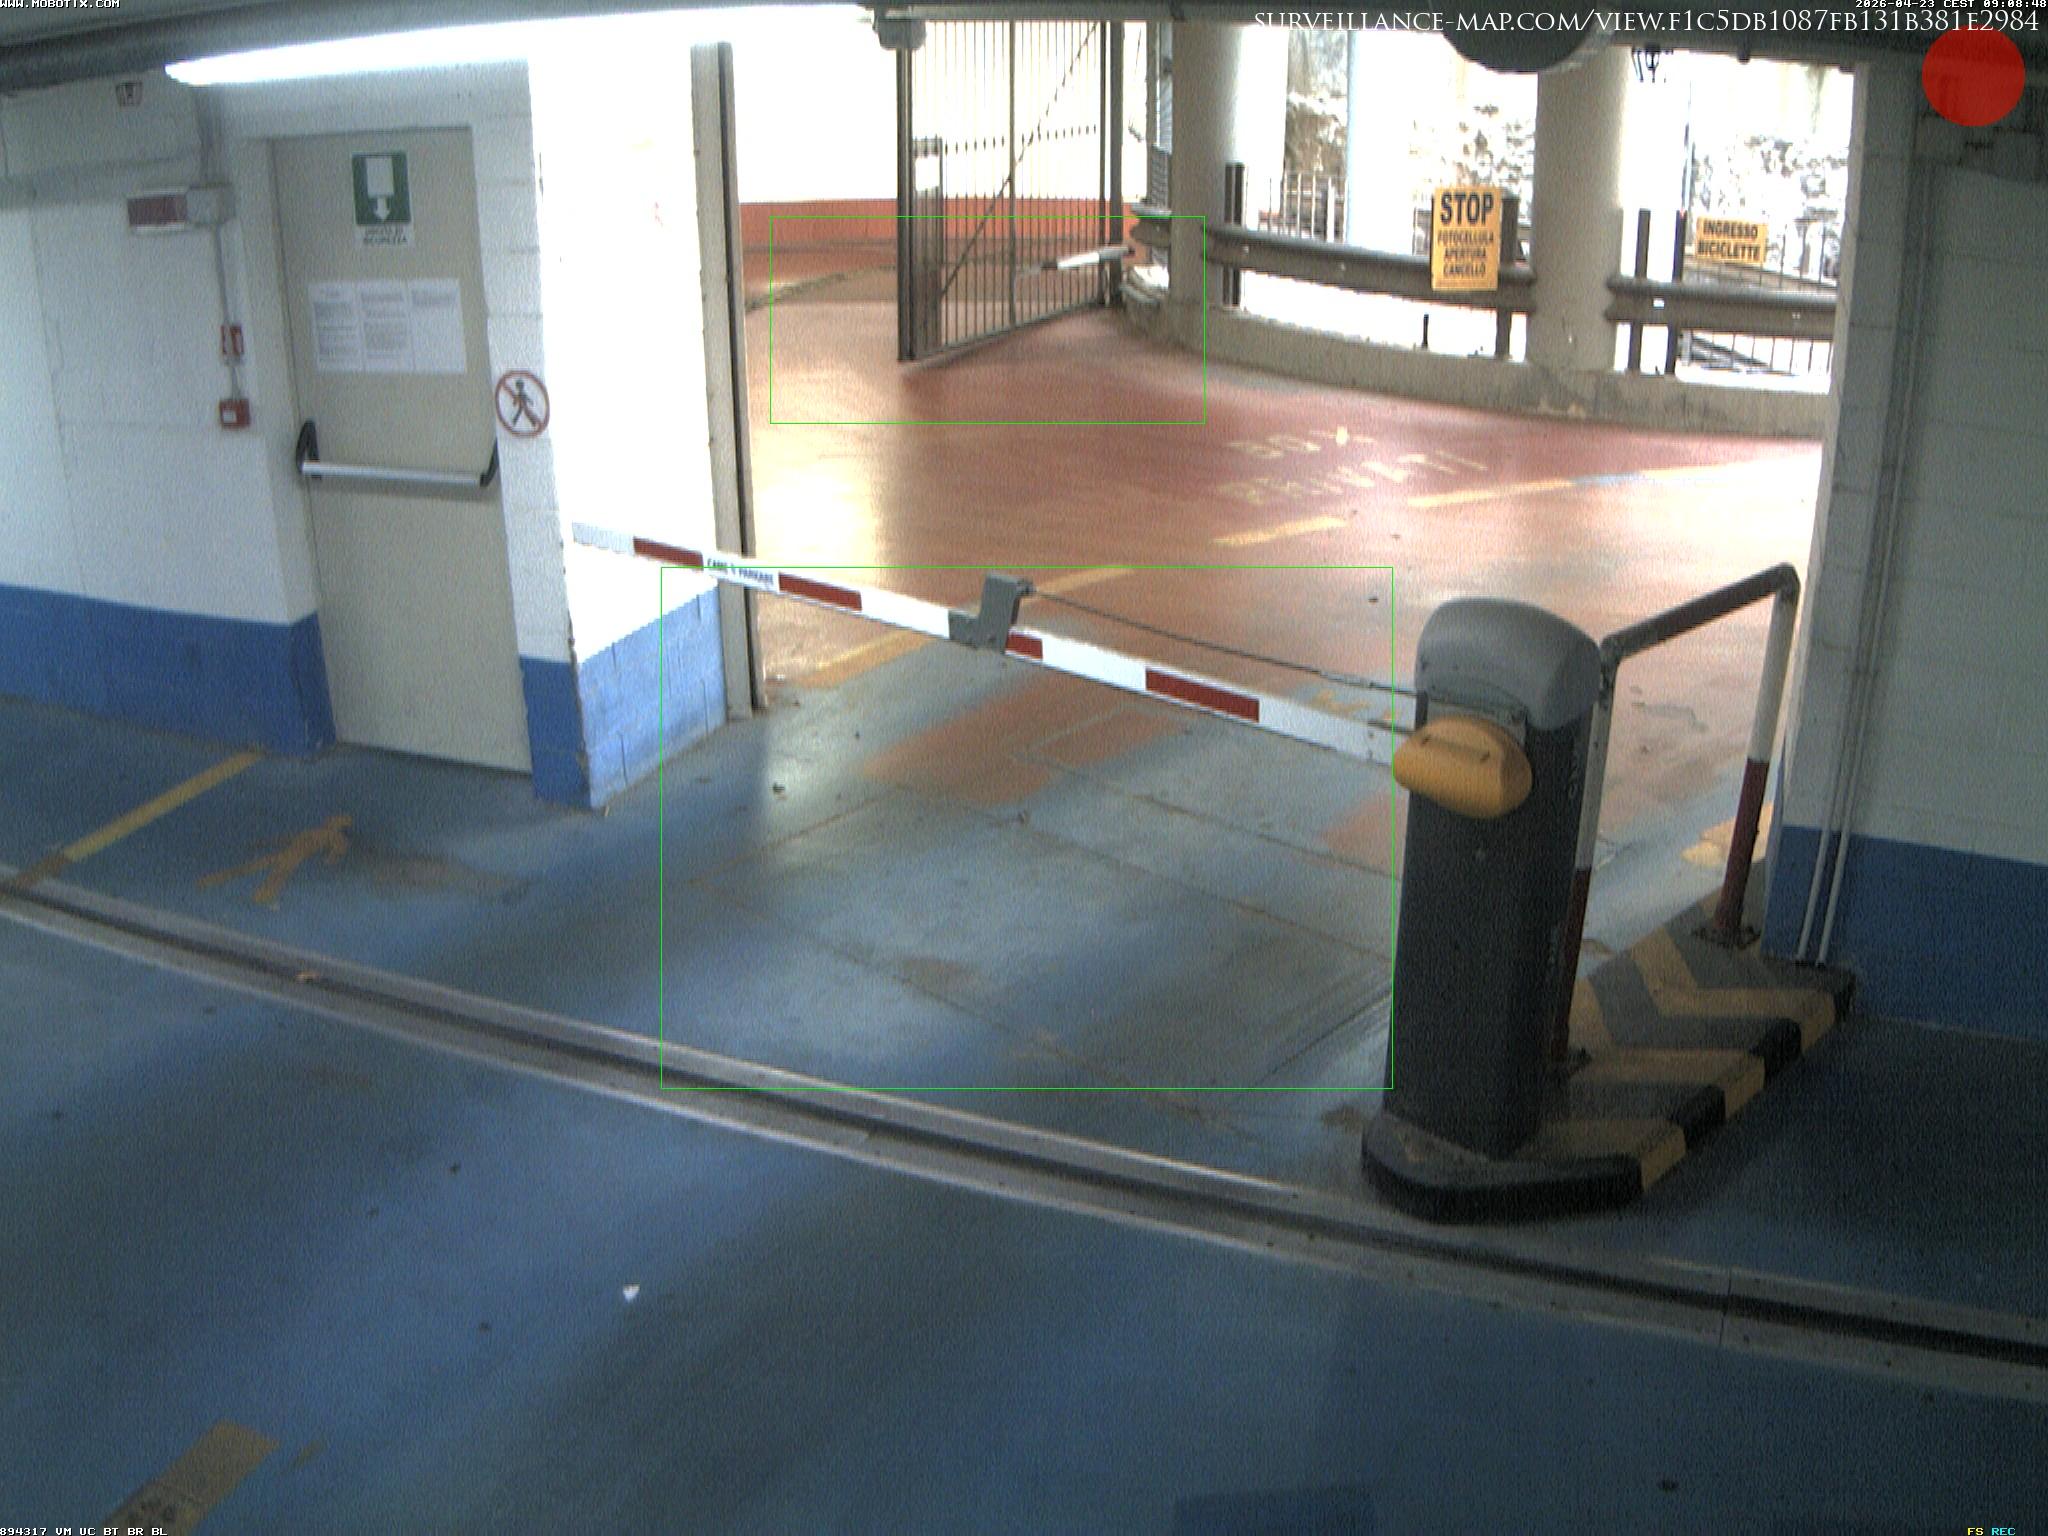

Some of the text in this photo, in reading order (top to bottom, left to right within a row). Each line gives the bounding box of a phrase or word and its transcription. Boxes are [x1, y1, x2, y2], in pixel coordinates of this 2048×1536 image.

[1440, 191, 1494, 226] STOP
[1703, 218, 1759, 240] INGRESSO
[1443, 247, 1488, 260] APERTURA
[1697, 239, 1762, 261] BICICLETTE
[1442, 261, 1487, 278] CANCELLO
